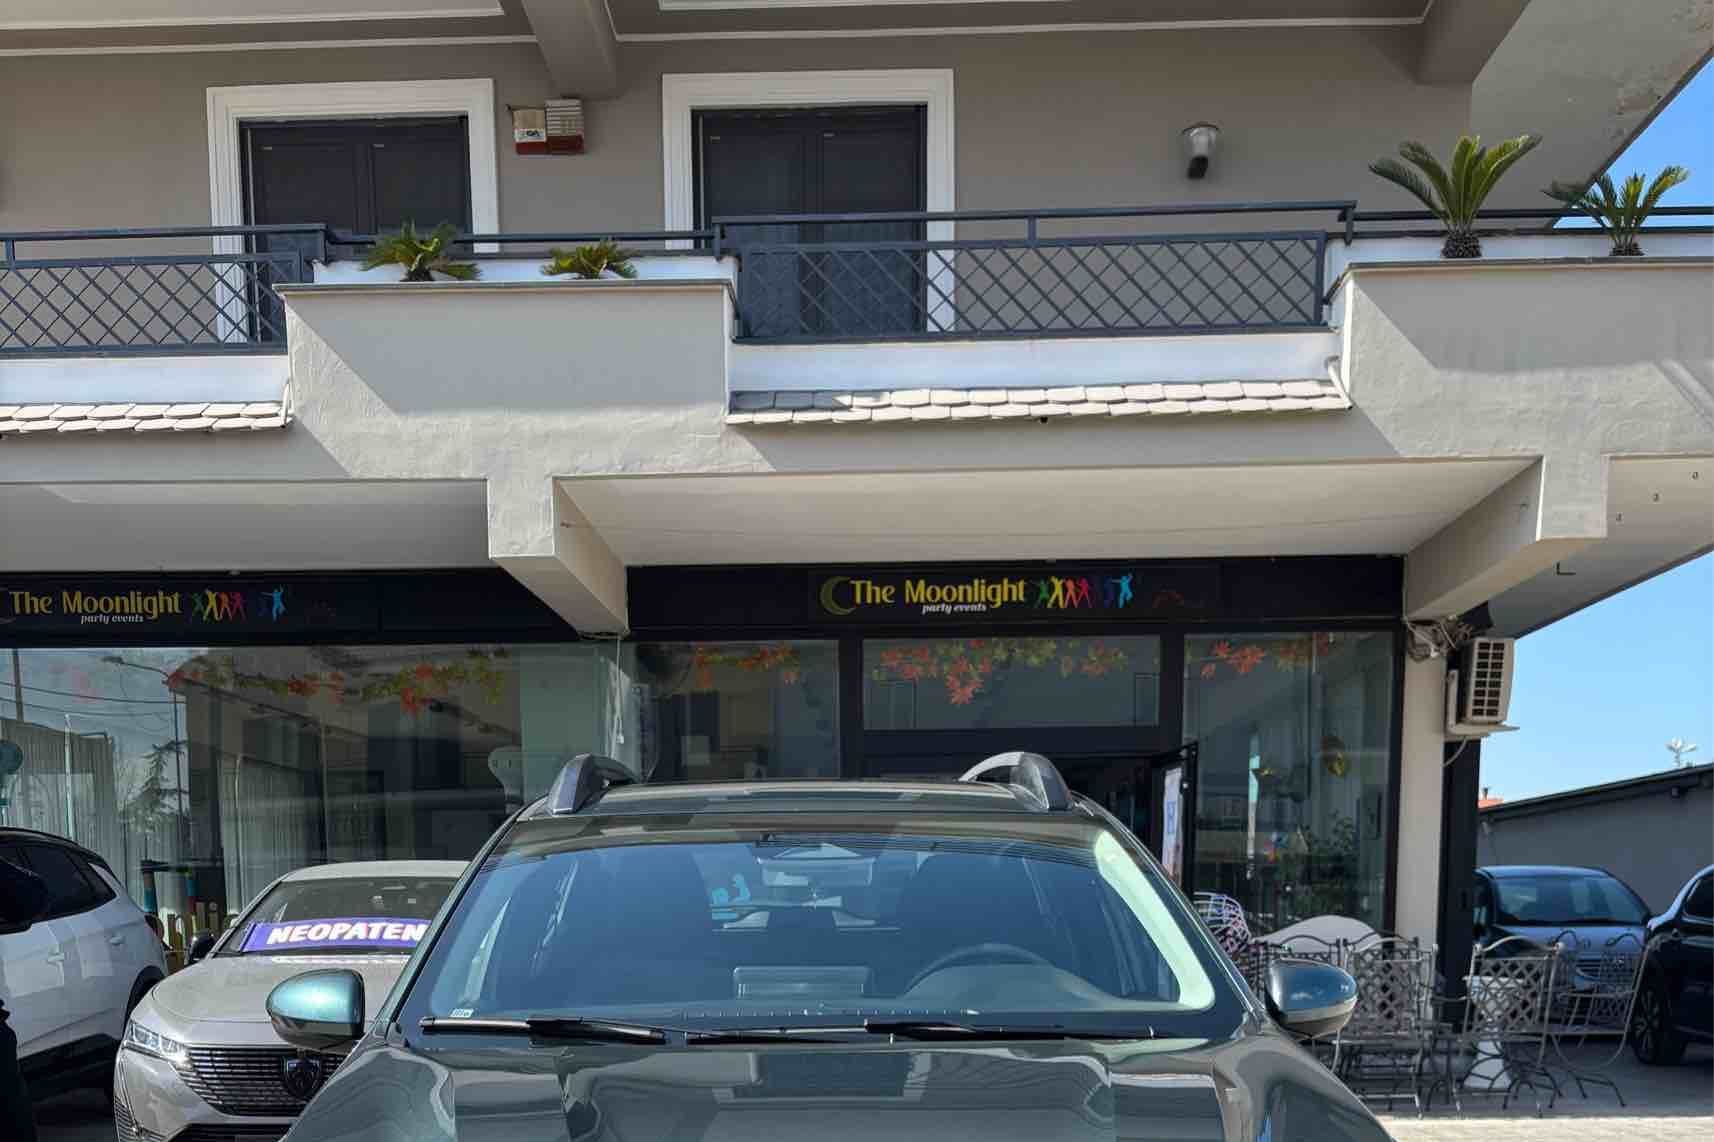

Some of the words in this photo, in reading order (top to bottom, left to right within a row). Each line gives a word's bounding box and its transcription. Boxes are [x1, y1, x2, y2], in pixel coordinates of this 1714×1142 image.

[850, 579, 896, 605] The
[904, 577, 1025, 608] Moonlight
[9, 590, 53, 615] The
[62, 590, 183, 619] Moonlight
[922, 603, 952, 615] party
[953, 603, 988, 613] events
[81, 614, 110, 625] party
[111, 614, 144, 624] events
